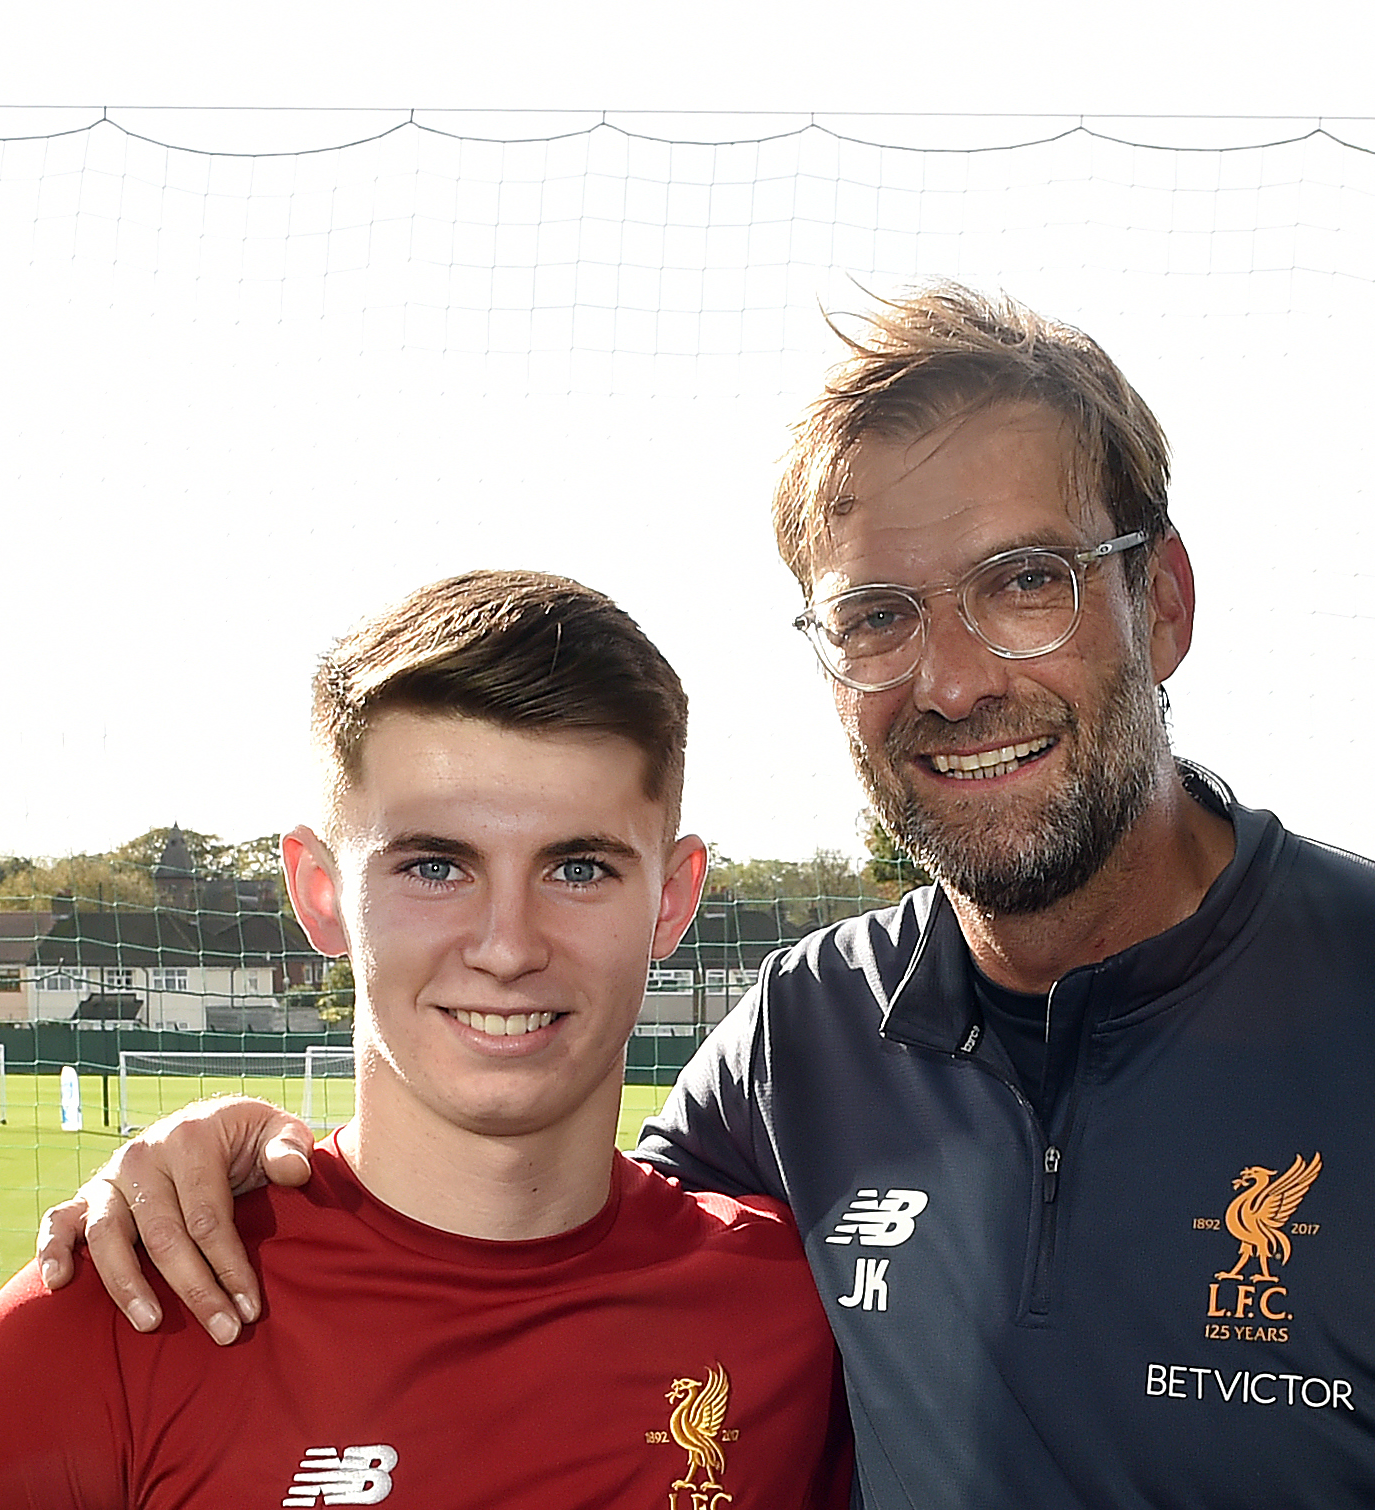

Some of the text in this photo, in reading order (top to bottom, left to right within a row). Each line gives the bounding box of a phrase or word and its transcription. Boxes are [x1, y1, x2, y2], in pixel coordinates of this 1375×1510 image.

[1192, 1218, 1320, 1235] 1892 2017
[837, 1257, 890, 1311] JK
[1207, 1283, 1294, 1320] L.F.C.
[1204, 1324, 1289, 1342] 125 YEARS
[1146, 1363, 1355, 1411] BETVICTOR
[645, 1431, 670, 1444] 1892
